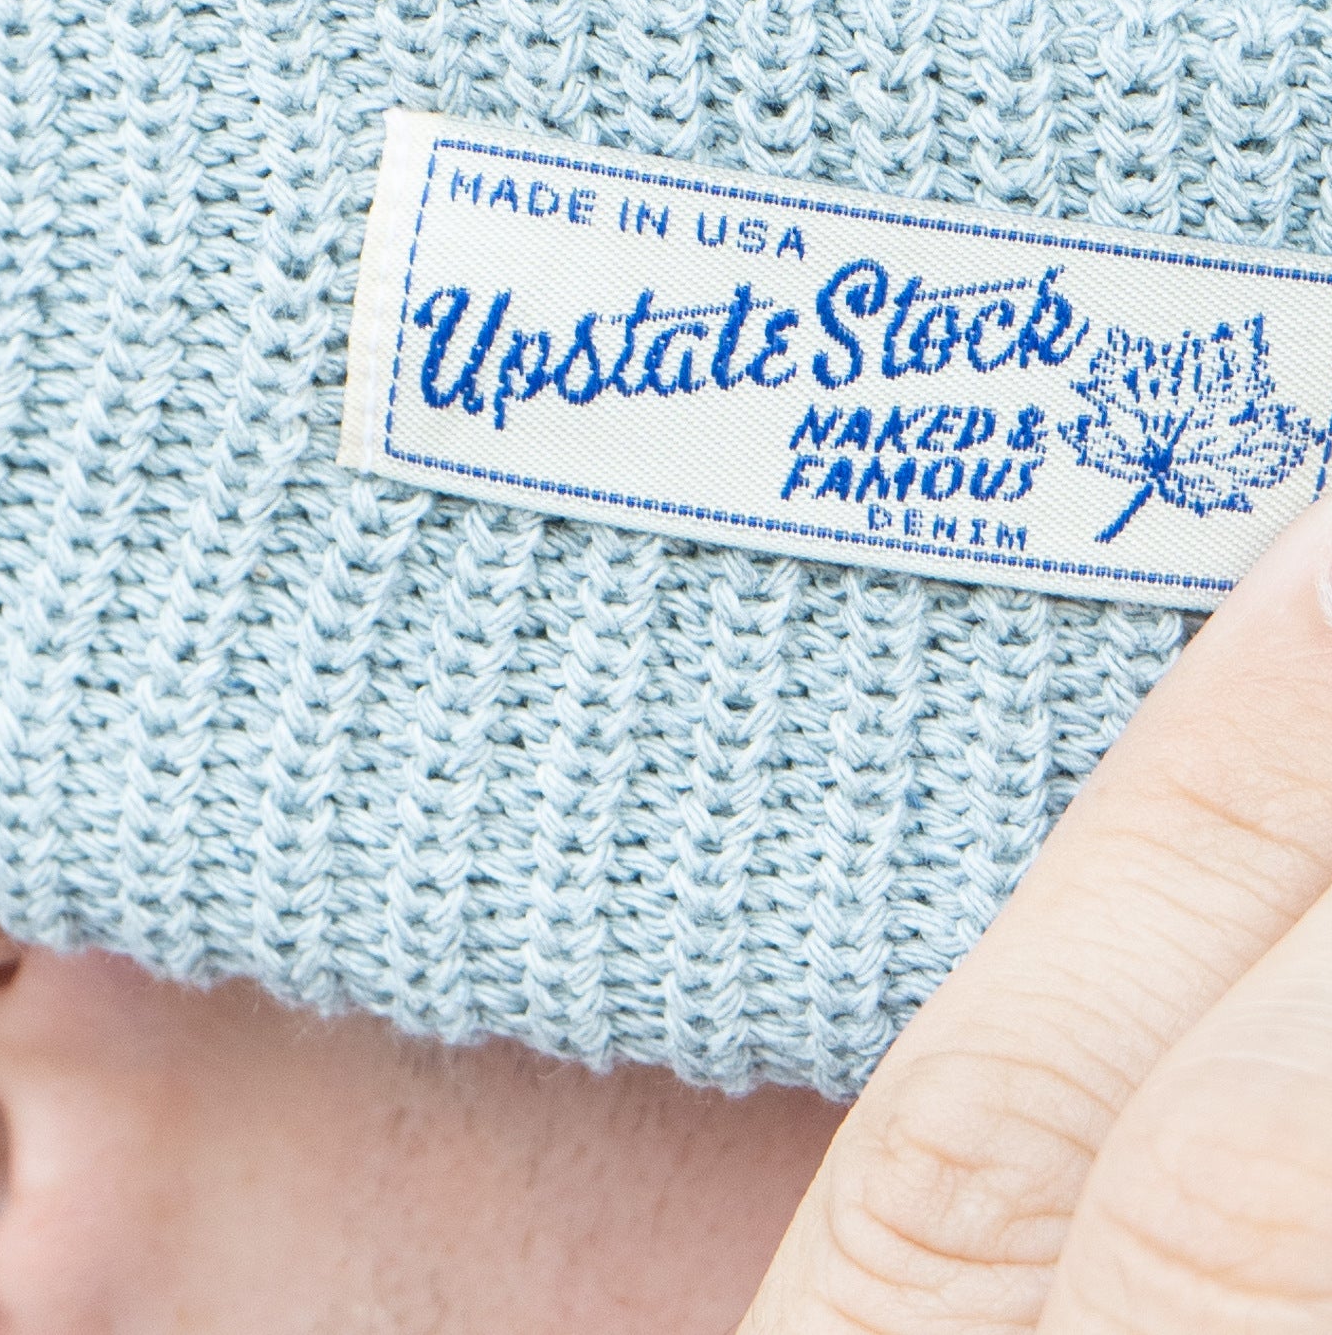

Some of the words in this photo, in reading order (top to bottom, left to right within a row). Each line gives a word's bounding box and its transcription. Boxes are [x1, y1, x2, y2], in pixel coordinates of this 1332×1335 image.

[451, 167, 594, 226] MADE
[619, 197, 668, 239] IN
[696, 212, 807, 261] USA
[414, 282, 800, 431] Upstate
[812, 259, 1090, 388] Stock
[789, 404, 997, 453] NAKED
[1005, 403, 1048, 452] &
[780, 455, 1045, 503] FAMOUS
[867, 502, 1027, 550] DENIM
